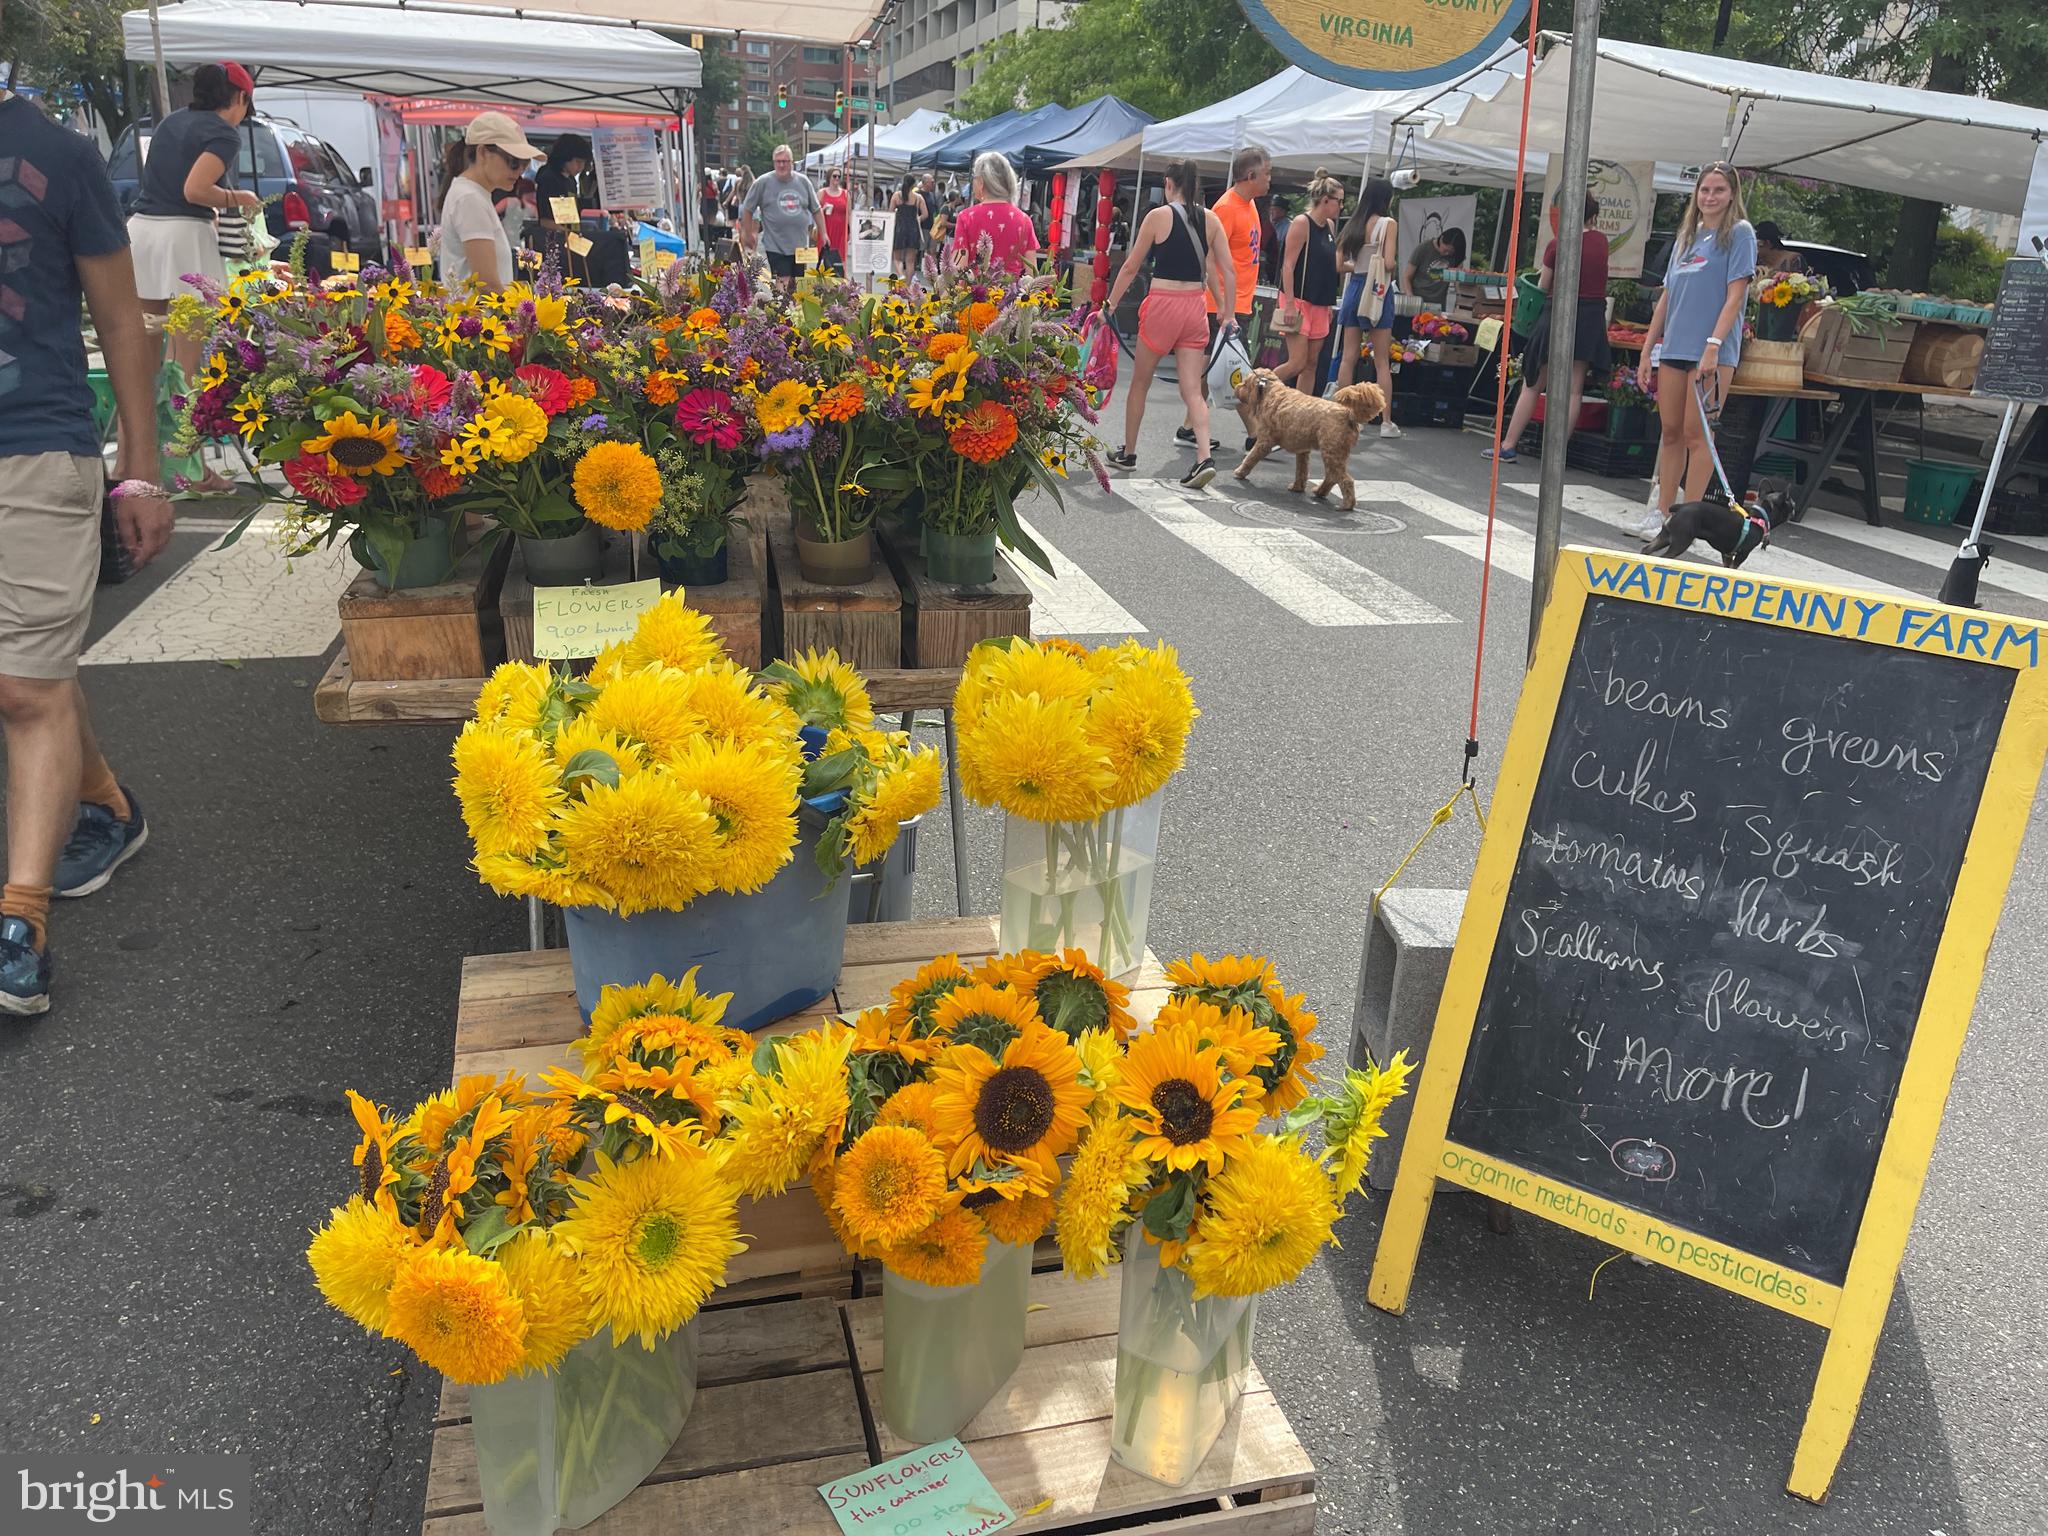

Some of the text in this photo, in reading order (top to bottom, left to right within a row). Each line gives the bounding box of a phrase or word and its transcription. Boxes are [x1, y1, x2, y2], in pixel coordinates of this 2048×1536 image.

[1424, 0, 1501, 15] UNTY
[1319, 13, 1414, 48] VIRGINIA
[1596, 196, 1631, 208] OMAC
[1599, 208, 1633, 220] TABLE
[1599, 219, 1621, 231] RMS
[537, 597, 646, 617] FLOWERS
[1584, 556, 2039, 668] WATERPENNY FARM
[595, 621, 633, 634] bunch
[536, 648, 560, 657] No
[1604, 667, 1729, 730] beans
[1781, 717, 1946, 782] greens
[1730, 876, 1846, 958] herbs
[1704, 968, 1849, 1052] flowers
[1442, 1149, 1809, 1307] organic methods no pesticides
[850, 1474, 949, 1523] this container
